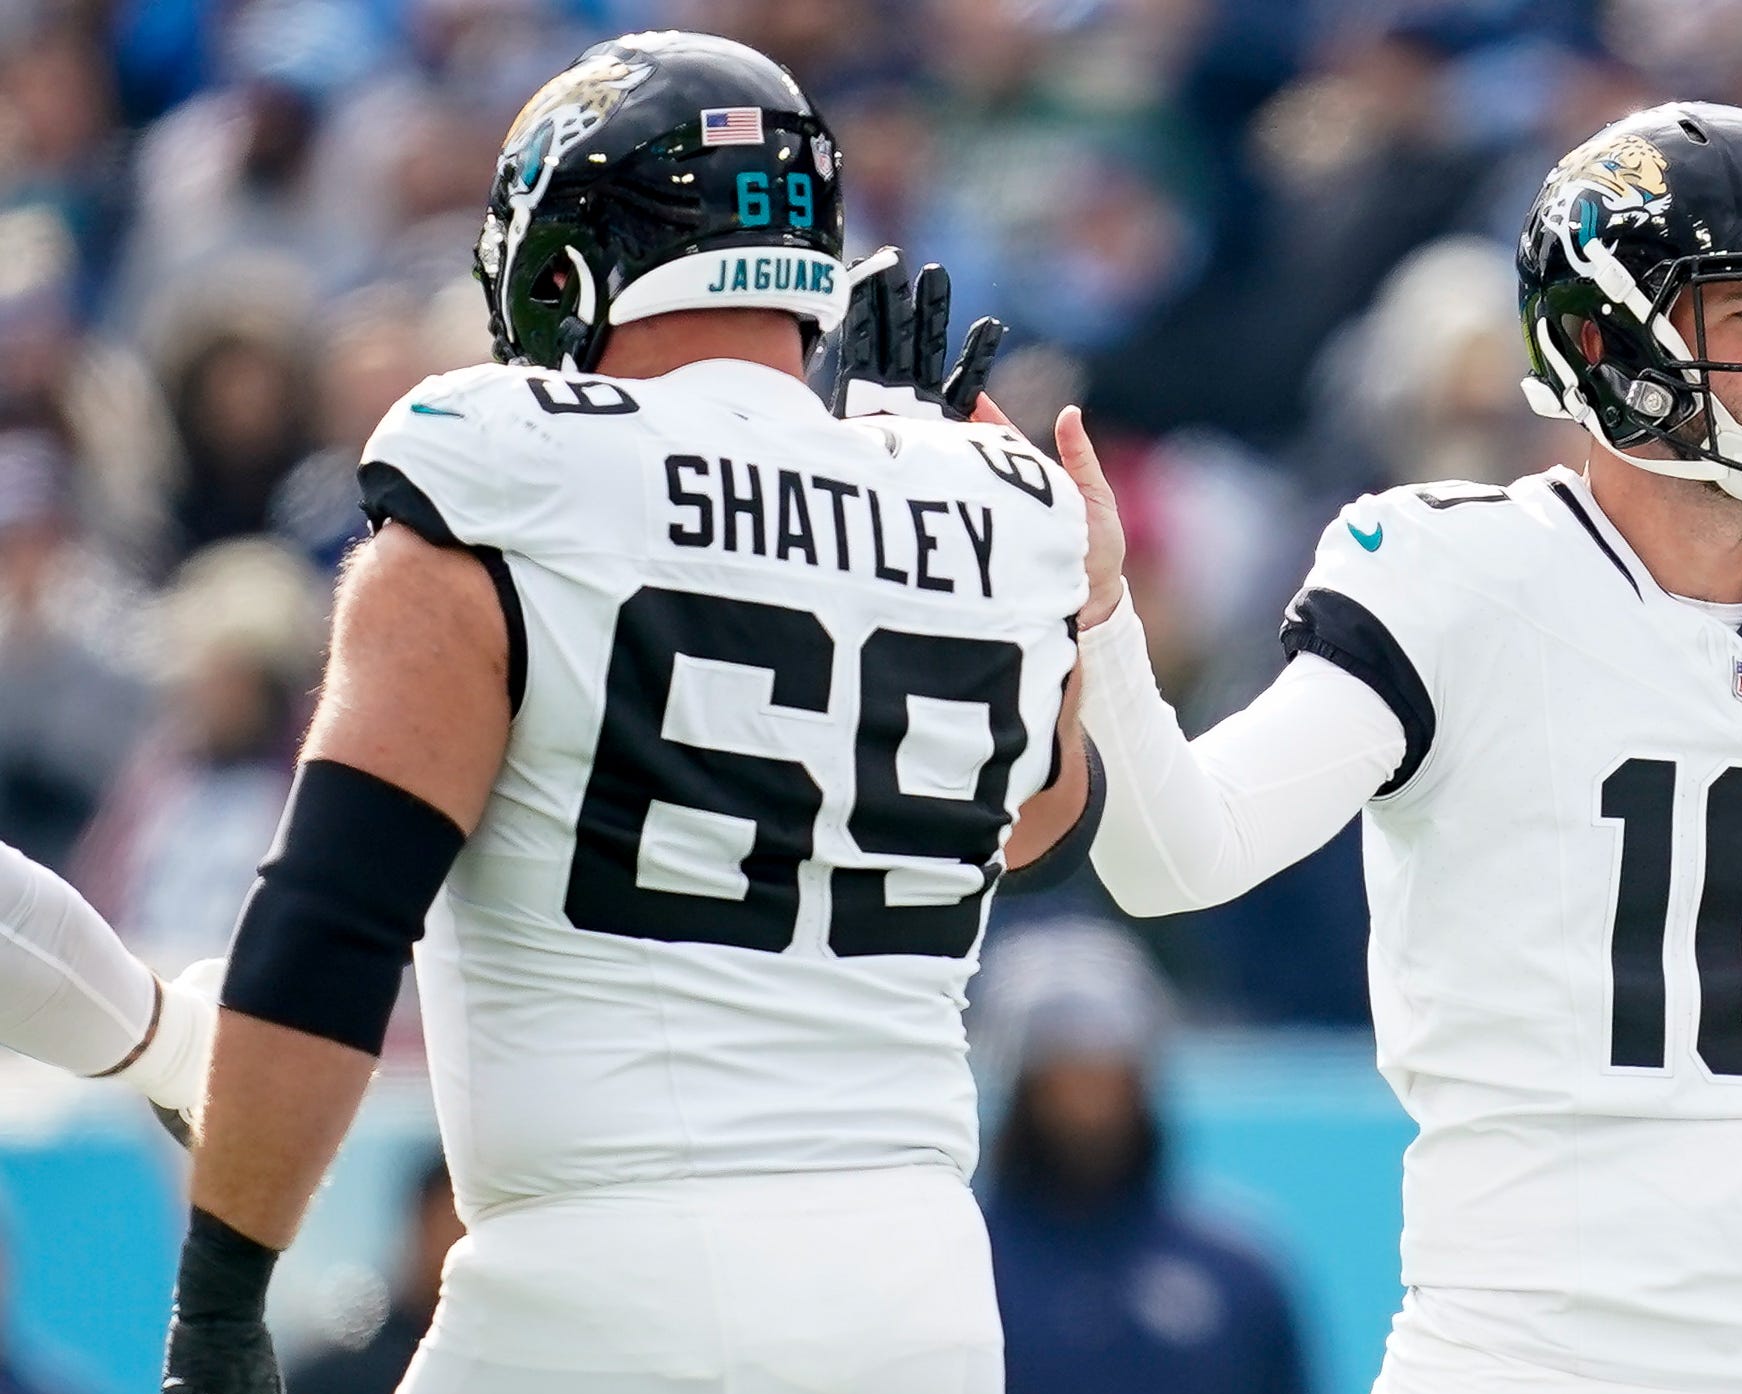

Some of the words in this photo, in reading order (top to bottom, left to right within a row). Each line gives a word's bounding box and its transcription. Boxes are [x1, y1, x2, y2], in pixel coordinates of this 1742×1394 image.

[736, 171, 814, 228] 69
[708, 258, 834, 294] JAGUARS
[663, 454, 993, 599] SHATLEY
[564, 585, 1028, 958] 69
